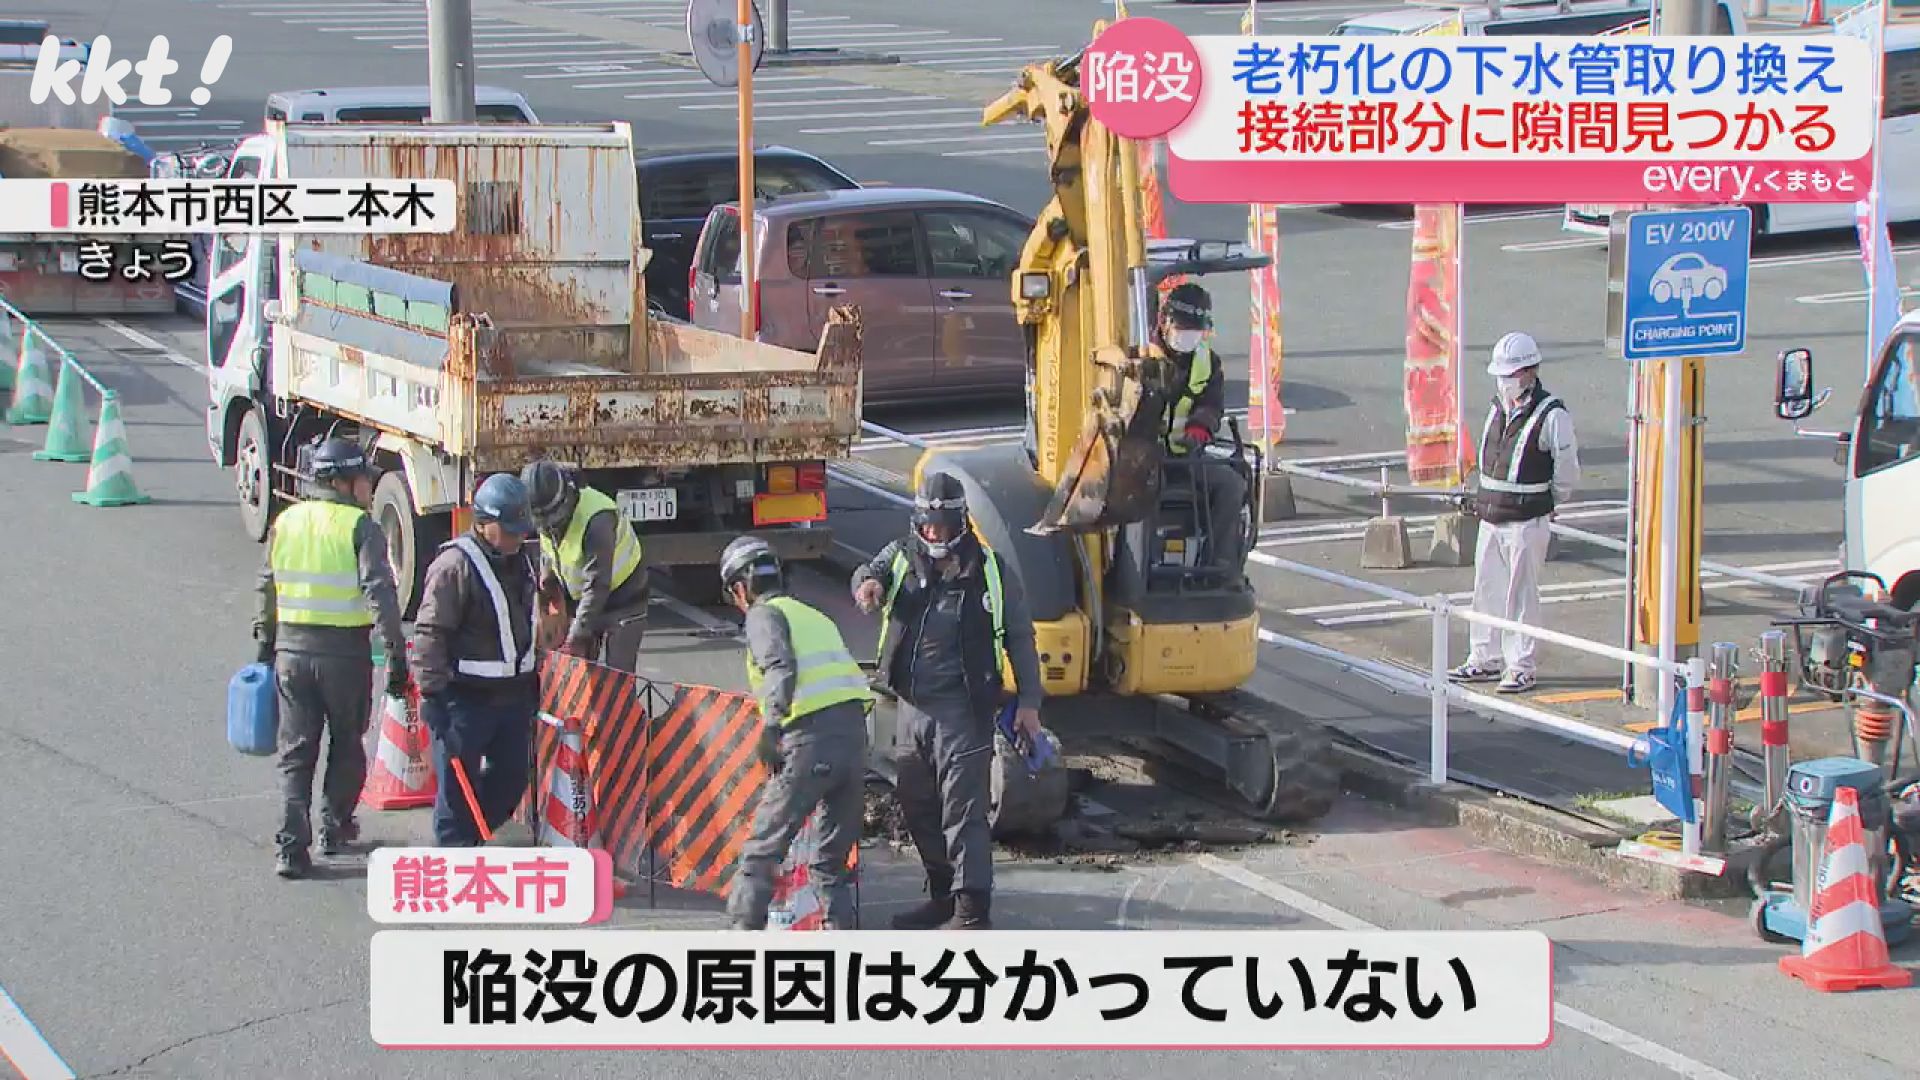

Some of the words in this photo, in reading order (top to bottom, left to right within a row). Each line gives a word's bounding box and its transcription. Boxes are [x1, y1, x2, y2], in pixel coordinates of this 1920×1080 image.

[1646, 223, 1674, 245] EV
[1680, 219, 1735, 242] 200V
[1635, 325, 1696, 341] CHARGING
[1699, 323, 1734, 337] POINT
